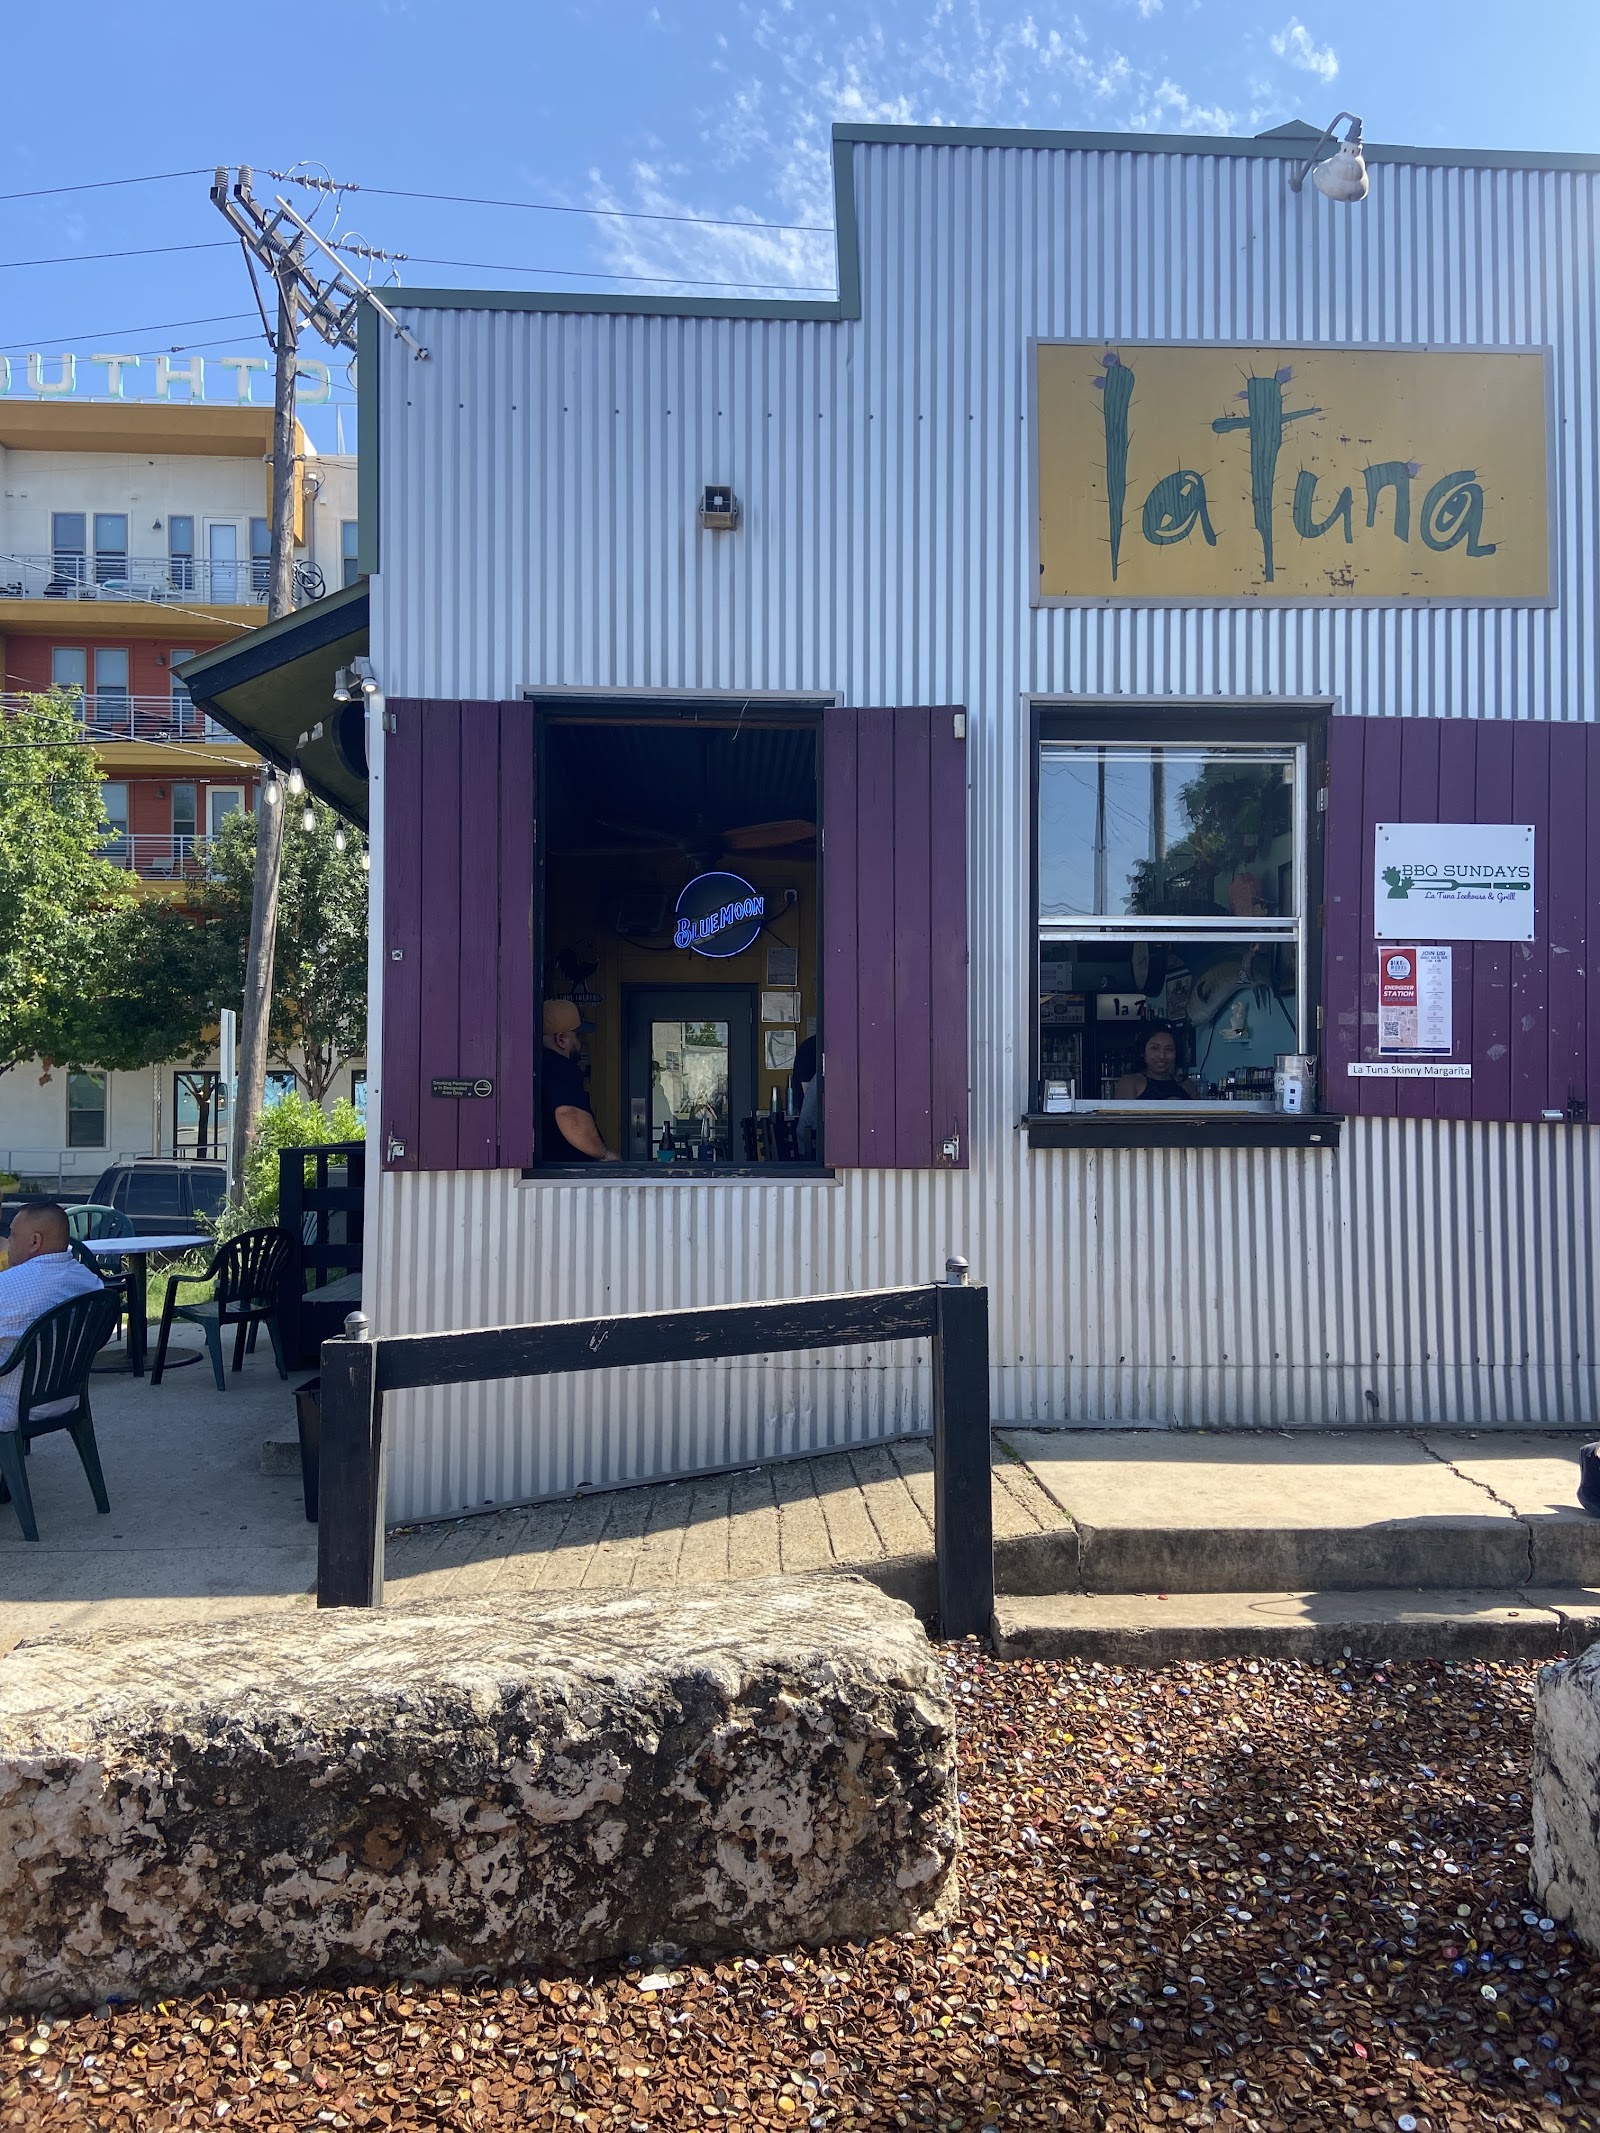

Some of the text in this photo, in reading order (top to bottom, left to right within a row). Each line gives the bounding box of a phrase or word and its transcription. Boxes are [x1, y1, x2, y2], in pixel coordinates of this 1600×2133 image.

[1402, 864, 1530, 878] BBQ SUNDAYS
[1424, 891, 1516, 904] La Tuna Icehouse & Grill
[674, 897, 765, 949] BLUE MOON
[1365, 1066, 1389, 1074] Tuna
[1391, 1066, 1422, 1076] Skinny
[1424, 1066, 1470, 1077] Margarita
